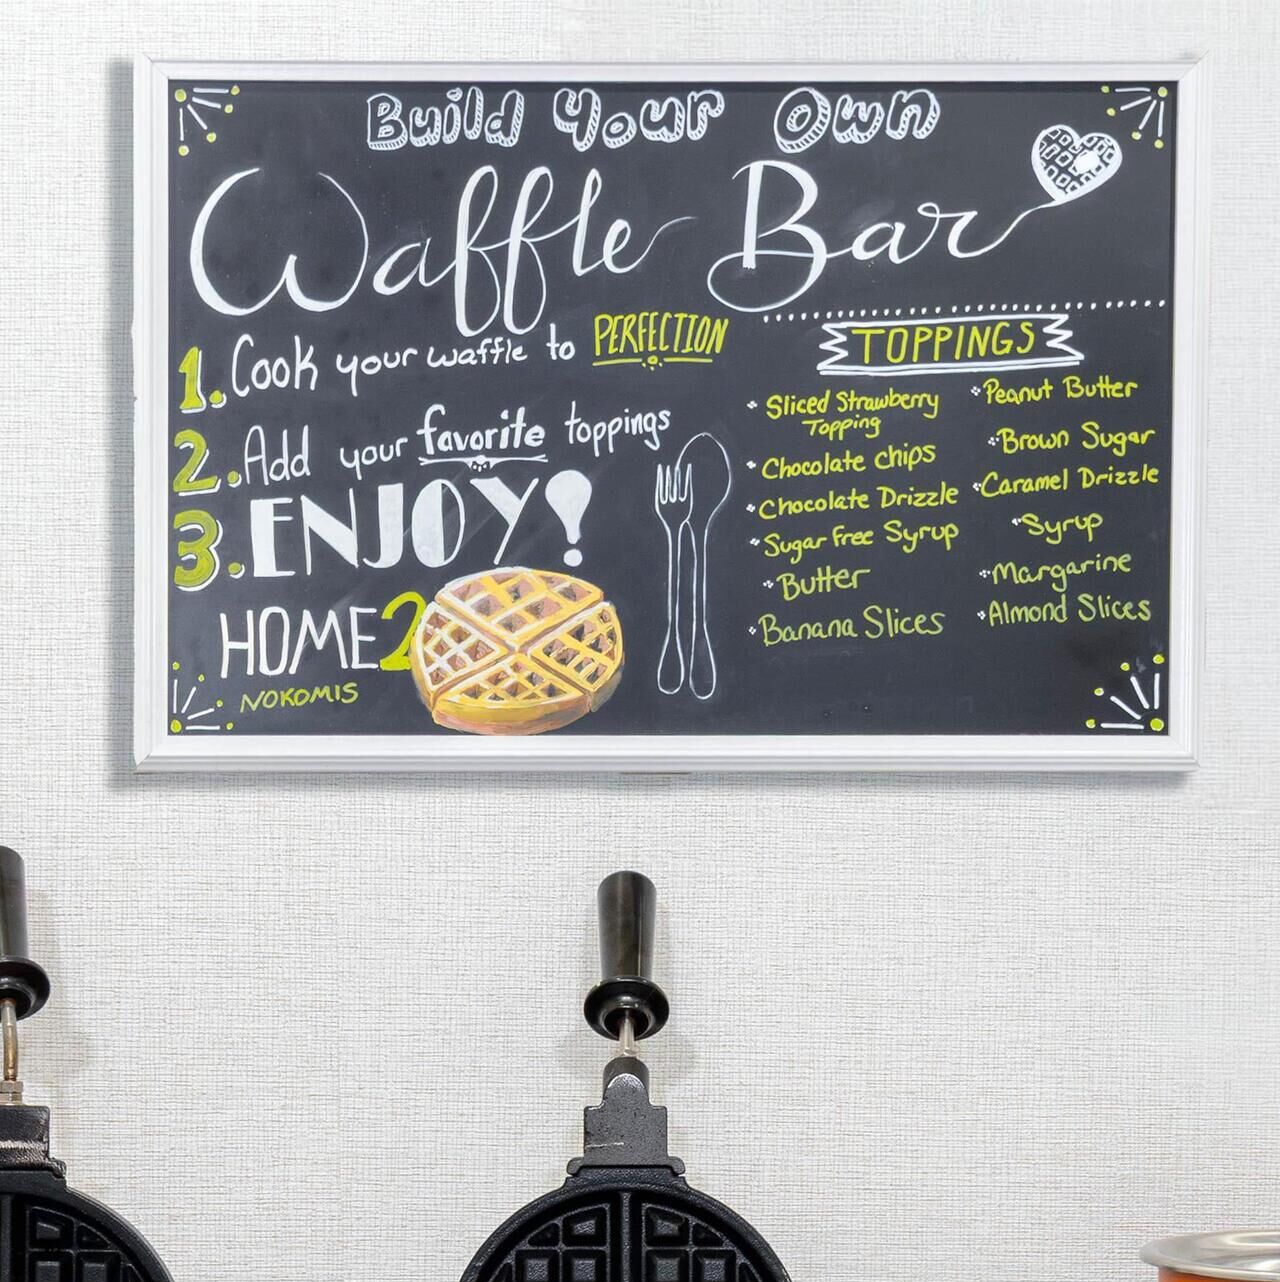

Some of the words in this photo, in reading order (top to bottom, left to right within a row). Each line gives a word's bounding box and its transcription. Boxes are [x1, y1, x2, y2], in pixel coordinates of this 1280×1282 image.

[367, 86, 524, 150] Build
[553, 88, 724, 151] Your
[774, 87, 940, 153] Own
[190, 165, 699, 337] Waffle
[707, 160, 1020, 312] Bar
[231, 334, 319, 397] Cook
[336, 348, 418, 396] your
[427, 338, 528, 367] waffle
[546, 323, 576, 363] to
[593, 311, 729, 356] PERFECTION
[851, 322, 1036, 365] TOPPINGS
[766, 389, 831, 419] Sliced
[836, 387, 939, 419] Strawberry
[983, 378, 1054, 405] Peanut
[1062, 375, 1138, 399] Butter
[243, 424, 311, 486] Add
[339, 437, 409, 479] your
[417, 404, 546, 455] favorite
[564, 401, 670, 456] toppings
[801, 414, 881, 440] Topping
[996, 427, 1070, 454] Brown
[1081, 421, 1155, 457] Sugar
[762, 450, 866, 479] Chocolate
[980, 468, 1068, 497] Caramel
[1077, 464, 1159, 489] Drizzle
[758, 488, 870, 520] Chocolate
[876, 481, 959, 508] Drizzle
[249, 469, 593, 578] ENJOY!
[764, 533, 827, 564] Sugar
[883, 519, 959, 553] Syrup
[1020, 513, 1103, 544] Syrup
[776, 565, 871, 601] Butter
[992, 554, 1131, 592] Margarine
[758, 613, 858, 647] Banana
[863, 605, 946, 639] Slices
[988, 594, 1068, 627] Almond
[1077, 593, 1151, 622] Slices
[239, 682, 359, 714] NOKOMIS
